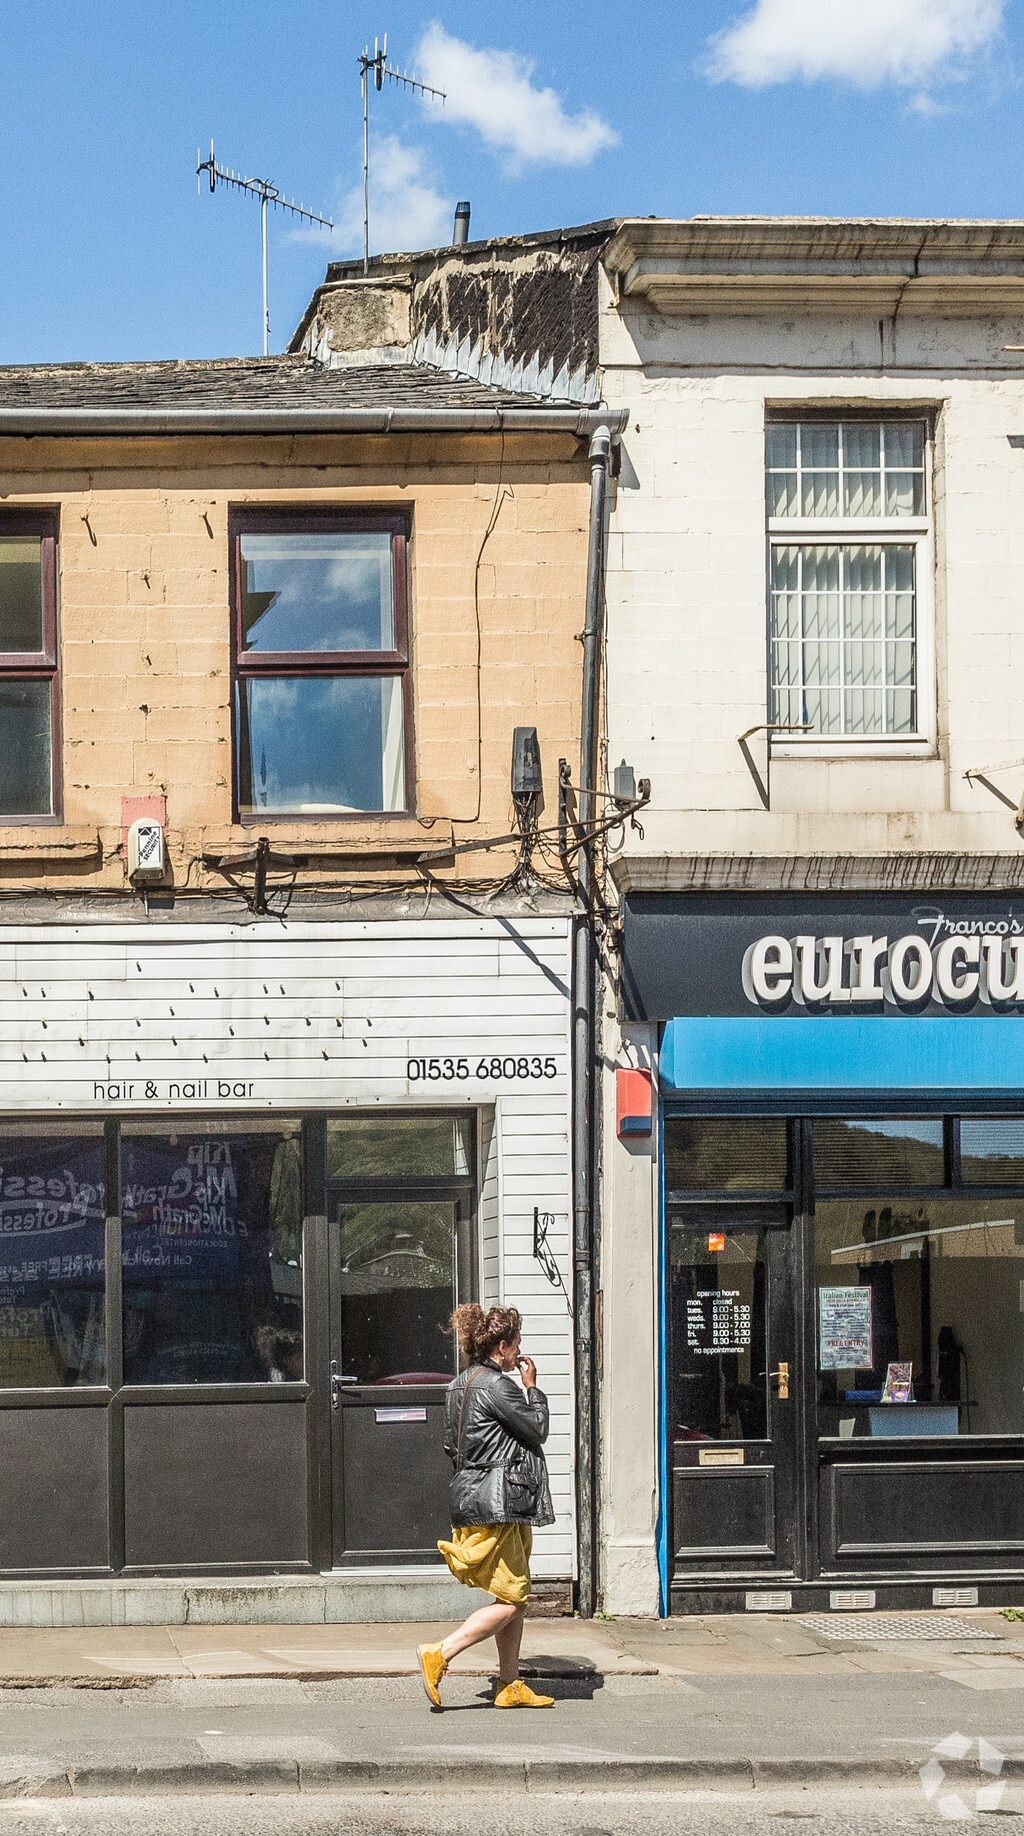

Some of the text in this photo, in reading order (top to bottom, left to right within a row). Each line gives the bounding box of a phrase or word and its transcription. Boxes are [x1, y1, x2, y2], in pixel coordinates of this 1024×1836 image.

[139, 831, 157, 857] Pennine
[407, 1057, 557, 1081] 01535 680835
[94, 1080, 254, 1100] hair & nail bar
[696, 1289, 740, 1298] opening hours
[844, 1291, 869, 1299] Festival
[734, 1313, 750, 1321] 5.30
[734, 1321, 750, 1329] 7.00
[734, 1329, 750, 1337] 5.30
[734, 1337, 750, 1345] 4.00
[703, 1346, 745, 1355] appointments
